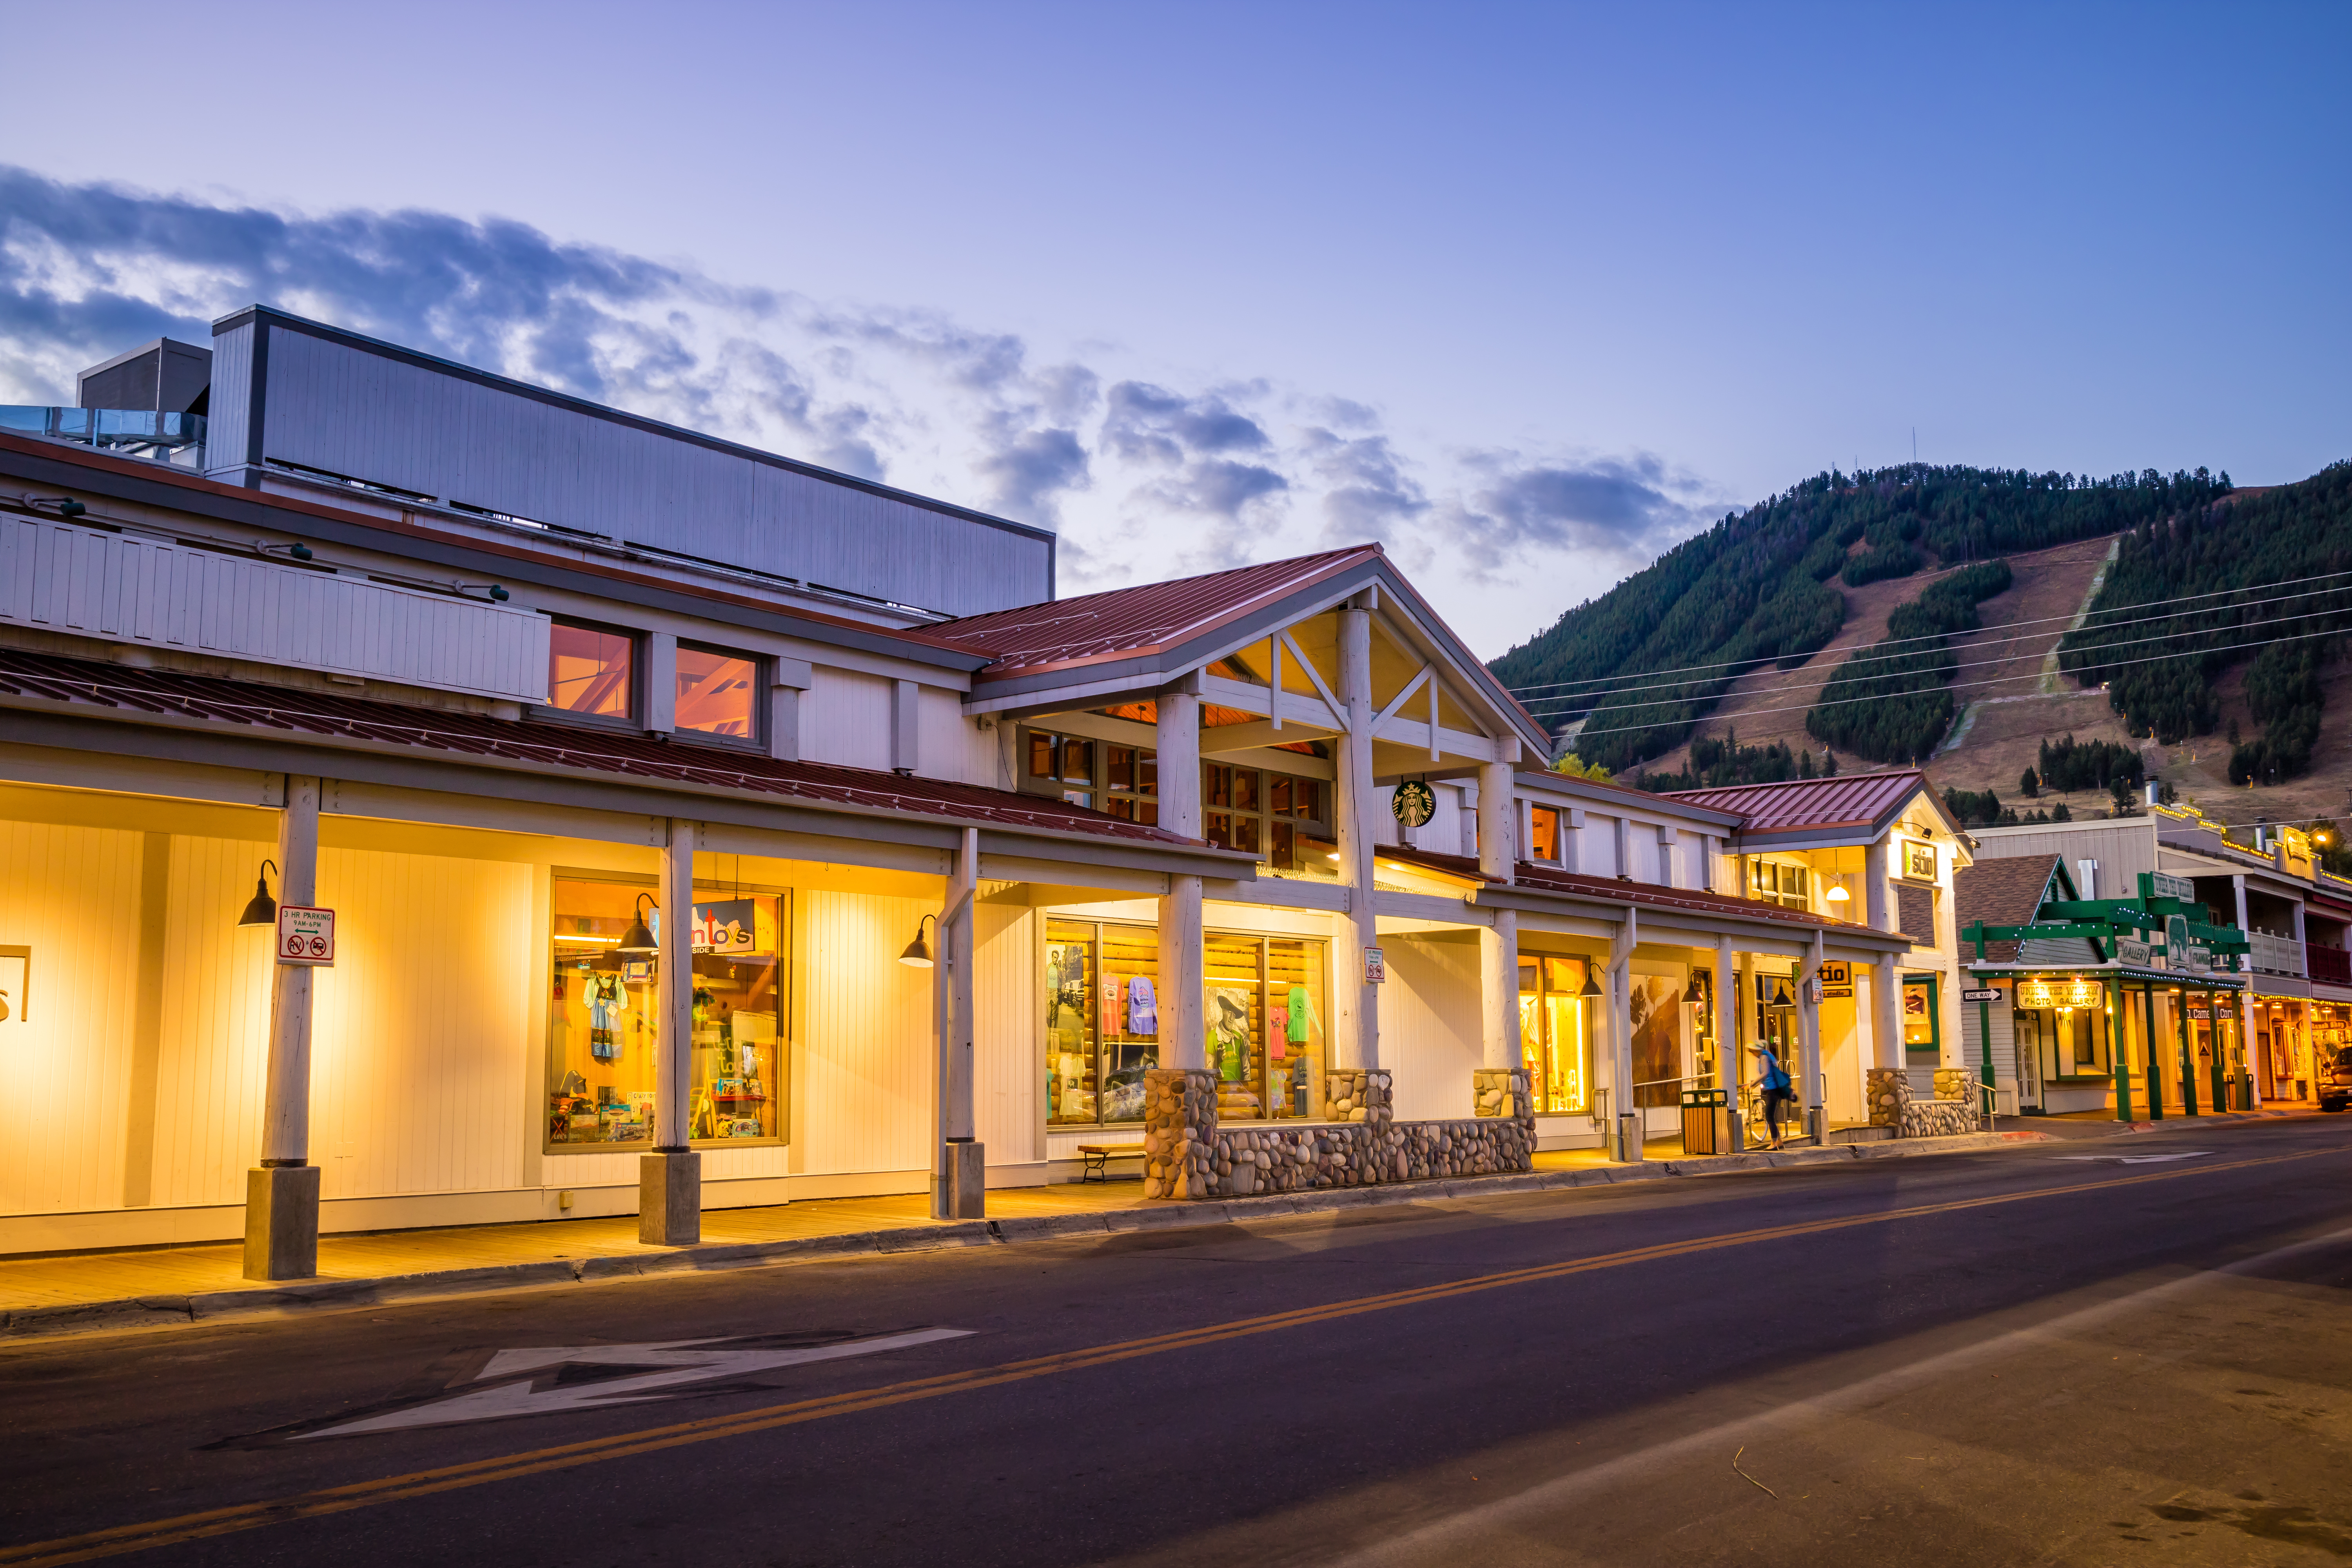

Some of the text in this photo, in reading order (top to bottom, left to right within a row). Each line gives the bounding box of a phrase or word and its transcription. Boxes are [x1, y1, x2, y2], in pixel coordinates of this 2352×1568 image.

[1913, 849, 1933, 876] stio
[303, 912, 331, 921] PARKING
[706, 908, 750, 947] toys
[290, 941, 301, 950] RV
[2123, 946, 2148, 962] GALLERY
[1817, 966, 1844, 981] tio
[2021, 986, 2098, 995] UNDER THE WILLOW
[2194, 1009, 2210, 1018] Came
